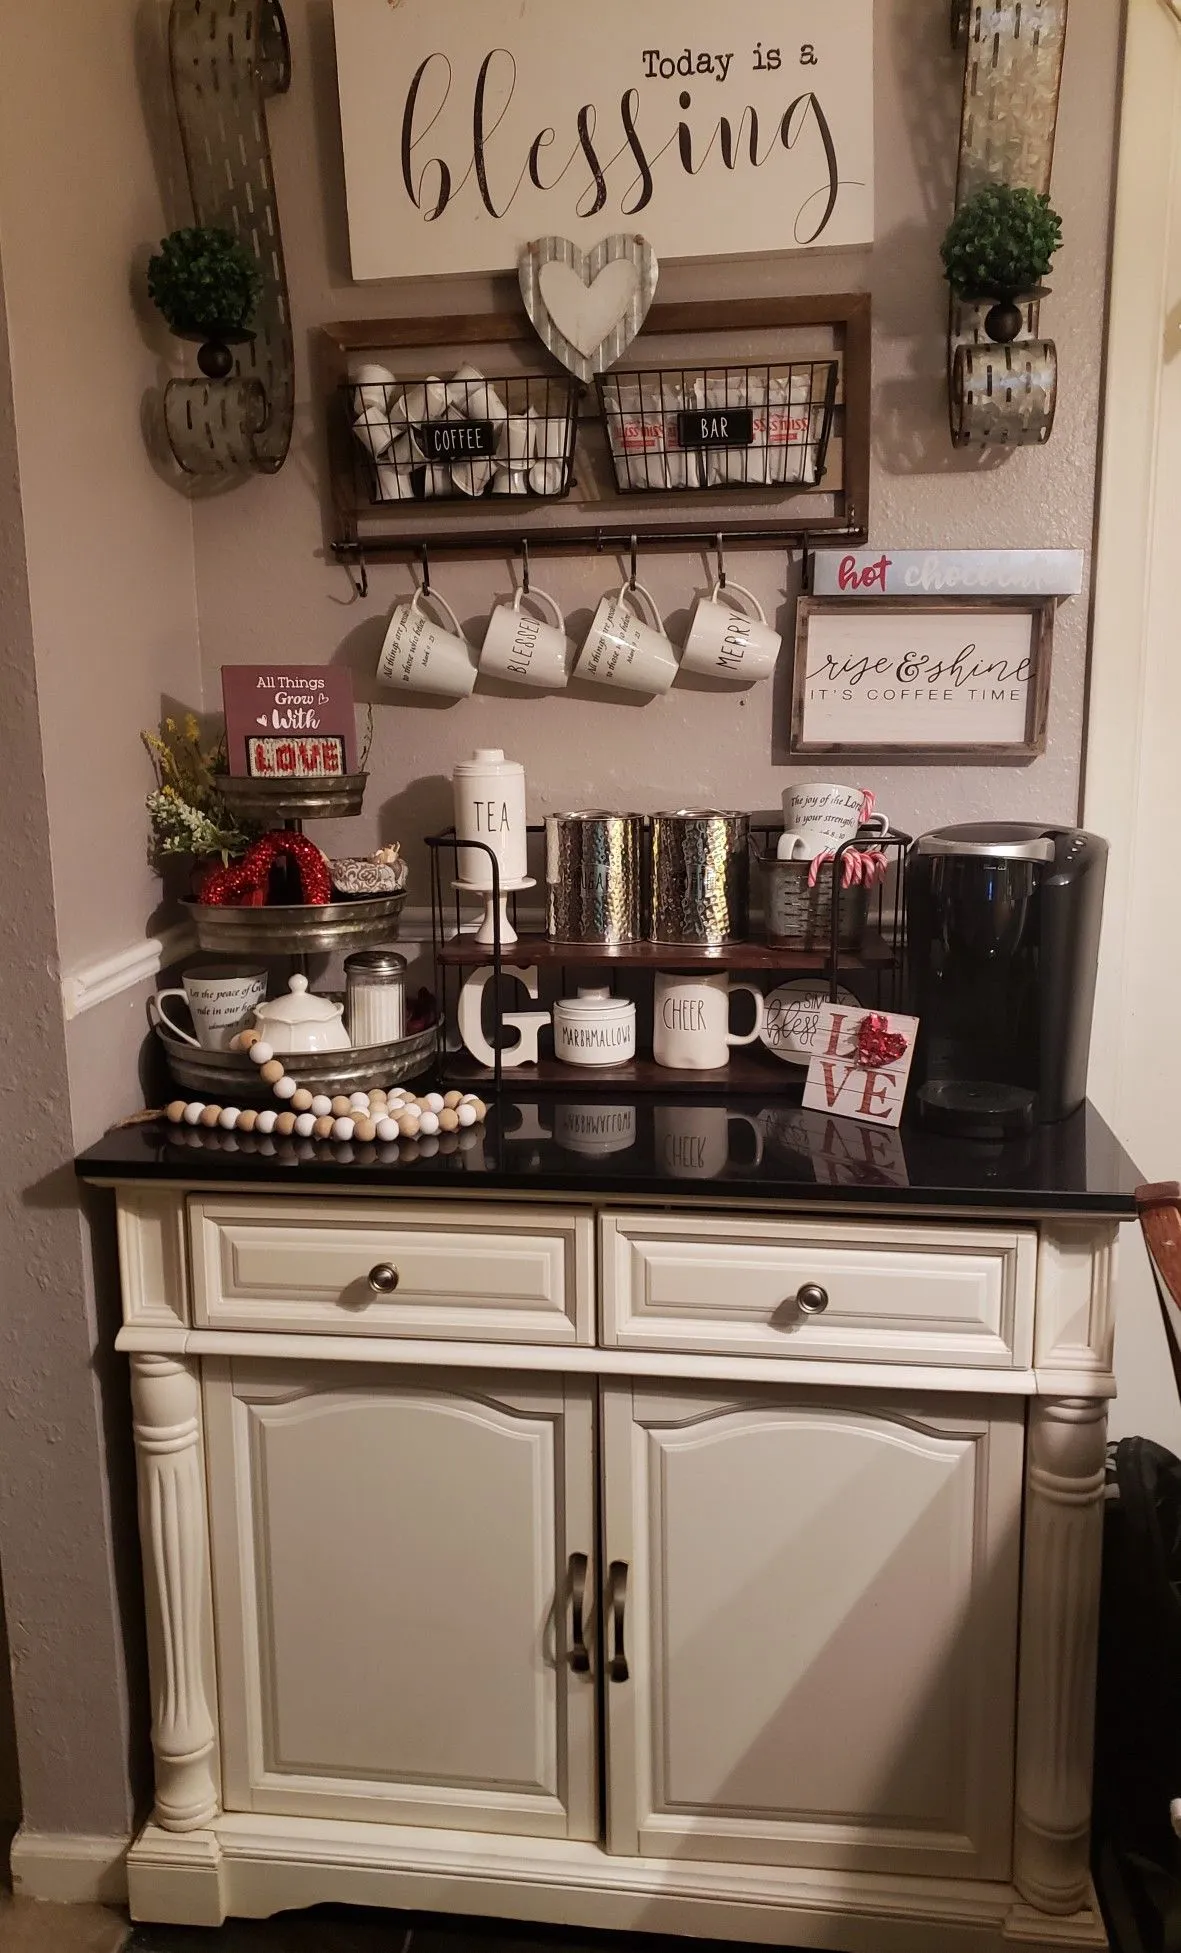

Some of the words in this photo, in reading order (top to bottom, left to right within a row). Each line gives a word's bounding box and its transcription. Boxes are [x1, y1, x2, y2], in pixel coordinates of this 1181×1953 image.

[642, 47, 734, 82] Today
[752, 42, 783, 72] is
[799, 44, 818, 65] a
[401, 48, 866, 244] blessing
[701, 416, 729, 439] BAR
[434, 427, 484, 451] COFFEE
[838, 554, 893, 592] hot
[395, 627, 403, 641] are
[409, 635, 419, 653] who
[716, 612, 752, 670] MERRY
[385, 641, 402, 667] things
[507, 617, 541, 674] BLESSED
[591, 637, 607, 663] things
[383, 663, 393, 679] All
[402, 654, 414, 674] those
[588, 660, 597, 675] All
[607, 650, 619, 671] those
[806, 653, 894, 686] rise
[927, 643, 1038, 687] shine
[256, 676, 276, 689] All
[277, 676, 326, 691] Things
[402, 674, 410, 682] to
[274, 691, 315, 705] Grow
[810, 688, 853, 701] IT'S
[866, 689, 954, 701] COFFEE
[968, 689, 1021, 701] TIME
[272, 708, 321, 730] With
[254, 741, 340, 773] LOVE
[791, 794, 804, 807] The
[801, 795, 818, 808] joy
[819, 794, 832, 807] of
[830, 794, 844, 805] the
[473, 801, 511, 832] TEA
[795, 815, 801, 823] is
[801, 814, 823, 826] your
[189, 988, 200, 998] Let
[201, 989, 214, 998] the
[213, 989, 240, 1002] peace
[241, 983, 252, 998] of
[212, 1007, 222, 1015] in
[224, 1006, 240, 1014] our
[458, 964, 551, 1067] G
[662, 997, 706, 1032] CHEER
[561, 1024, 631, 1048] MARSHMALLOWS
